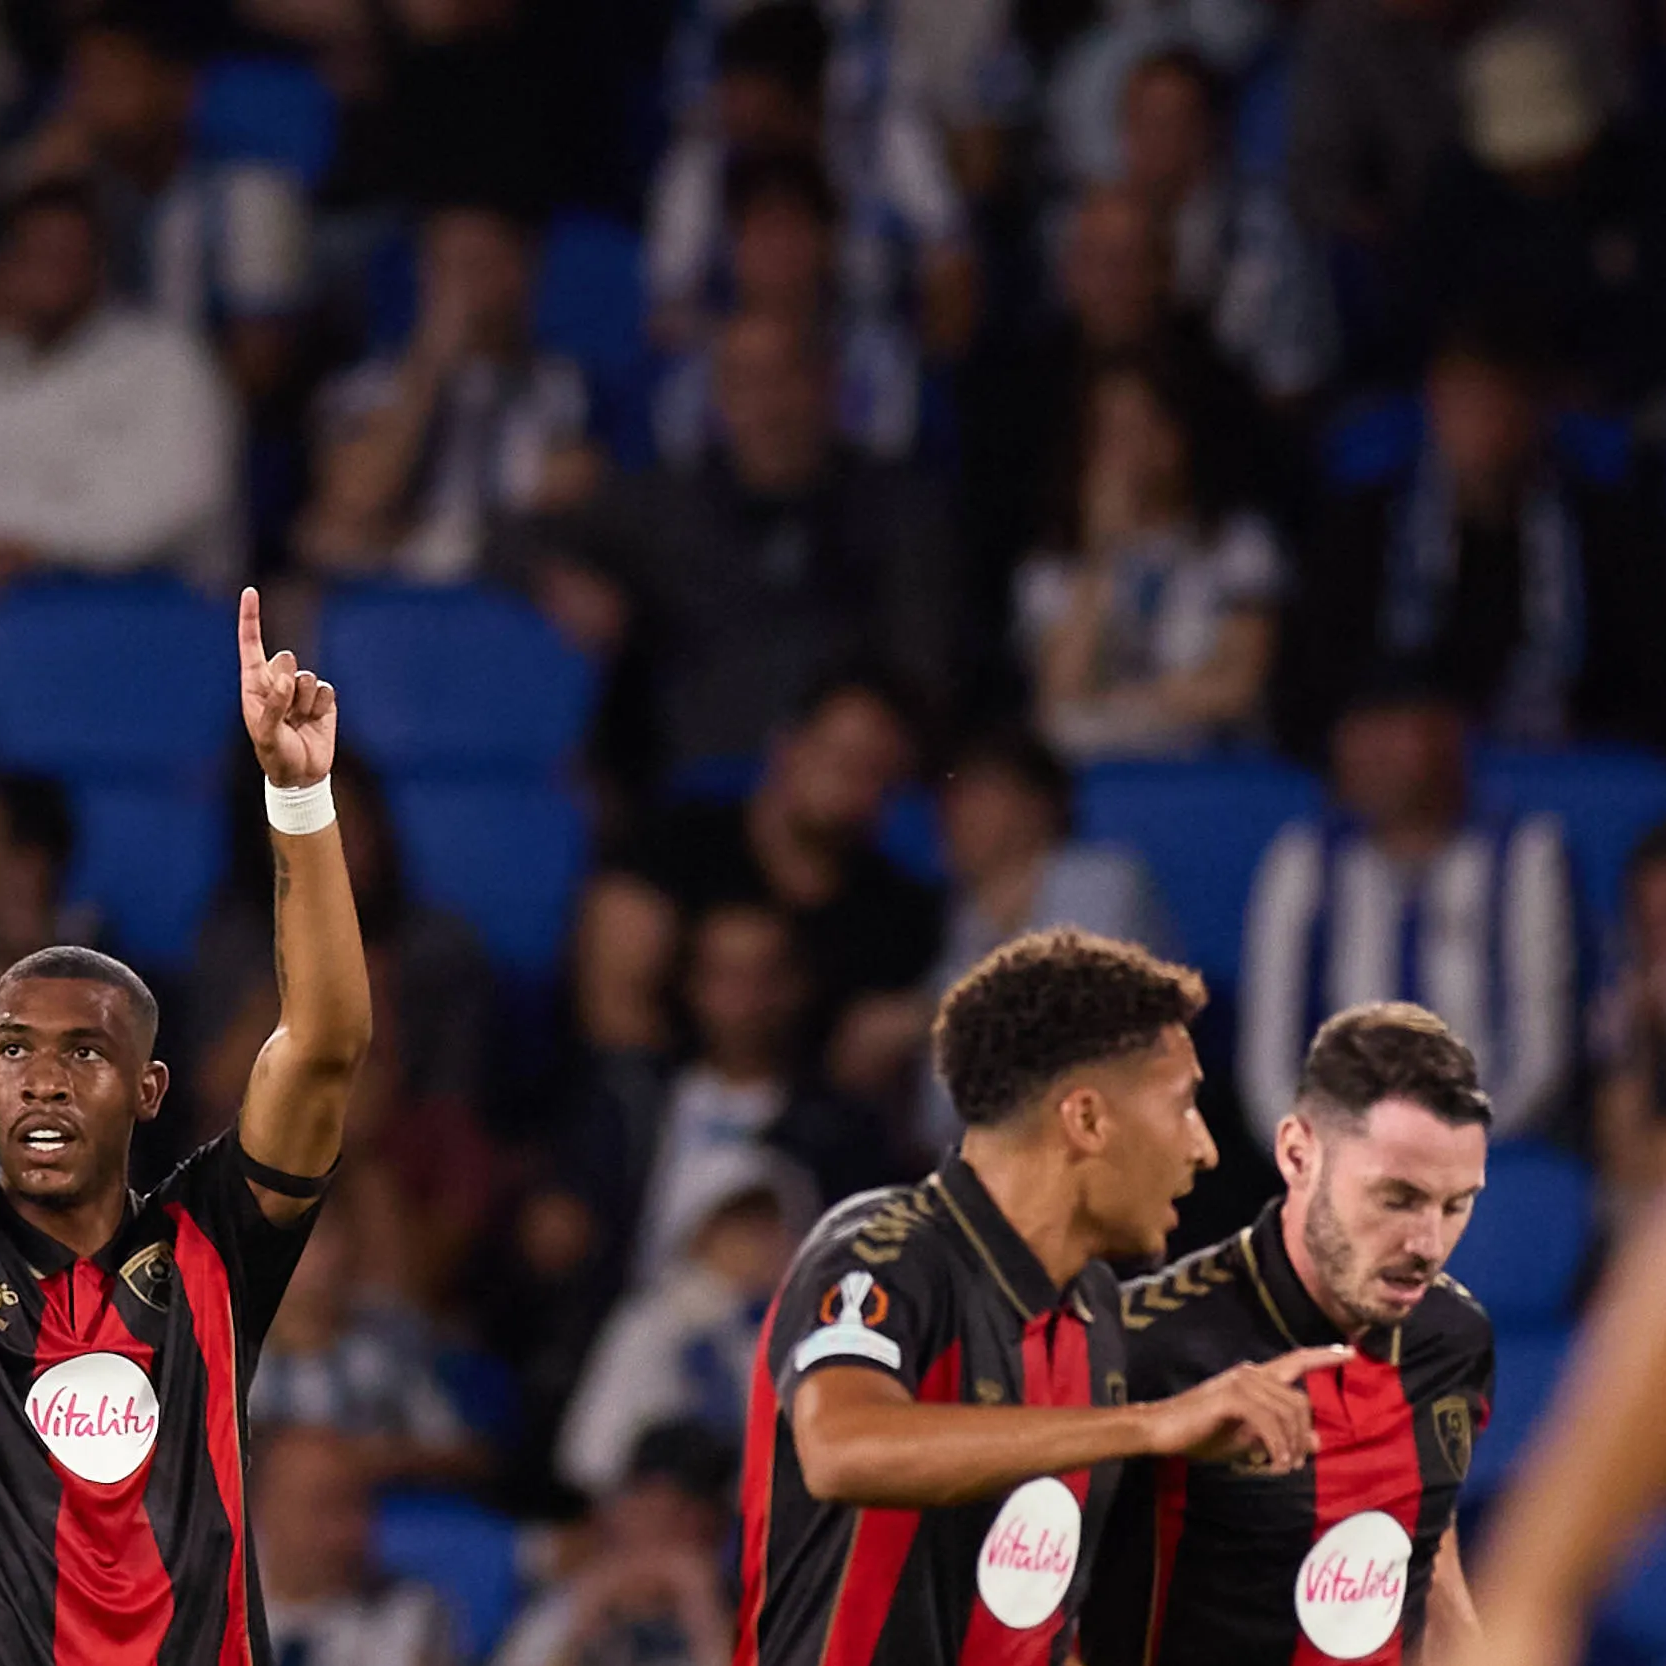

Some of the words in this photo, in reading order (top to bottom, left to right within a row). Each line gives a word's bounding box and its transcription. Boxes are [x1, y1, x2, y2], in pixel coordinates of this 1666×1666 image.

[32, 1385, 155, 1446] Vitality
[988, 1514, 1071, 1593] Vitality
[1305, 1549, 1400, 1618] Vitality
